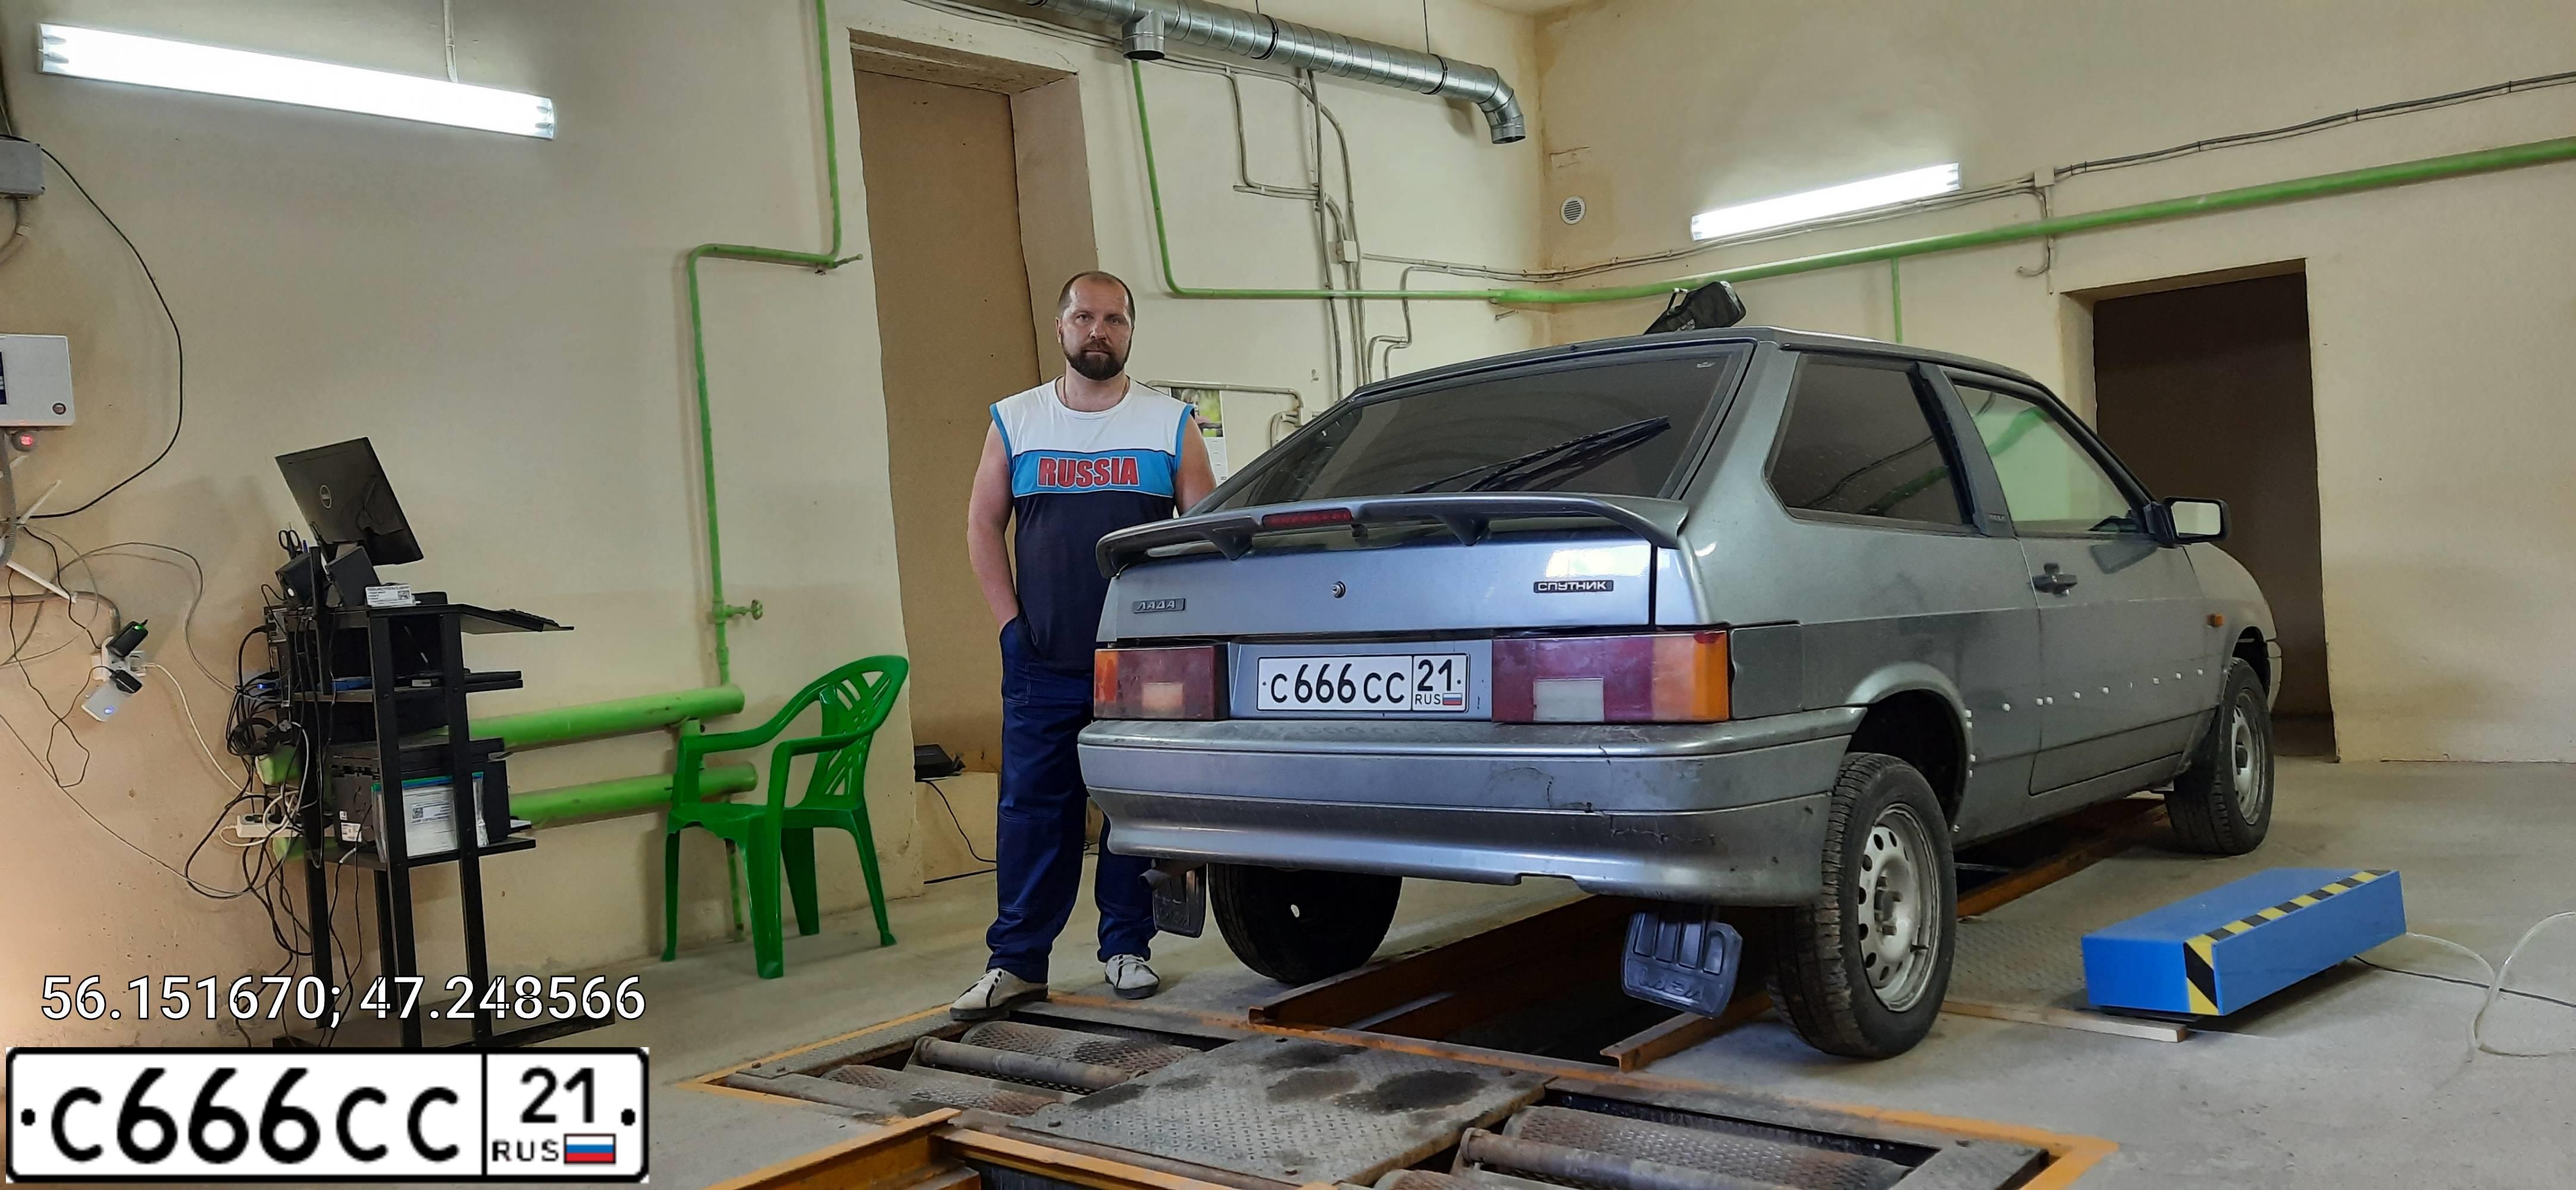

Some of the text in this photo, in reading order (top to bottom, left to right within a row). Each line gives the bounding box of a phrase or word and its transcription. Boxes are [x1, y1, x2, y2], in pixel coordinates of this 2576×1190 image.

[1037, 456, 1140, 488] RUSSIA
[1538, 581, 1607, 591] СПУТНИК
[1137, 600, 1175, 611] ЛАДА
[1417, 659, 1452, 691] 21
[1414, 694, 1441, 705] RUS
